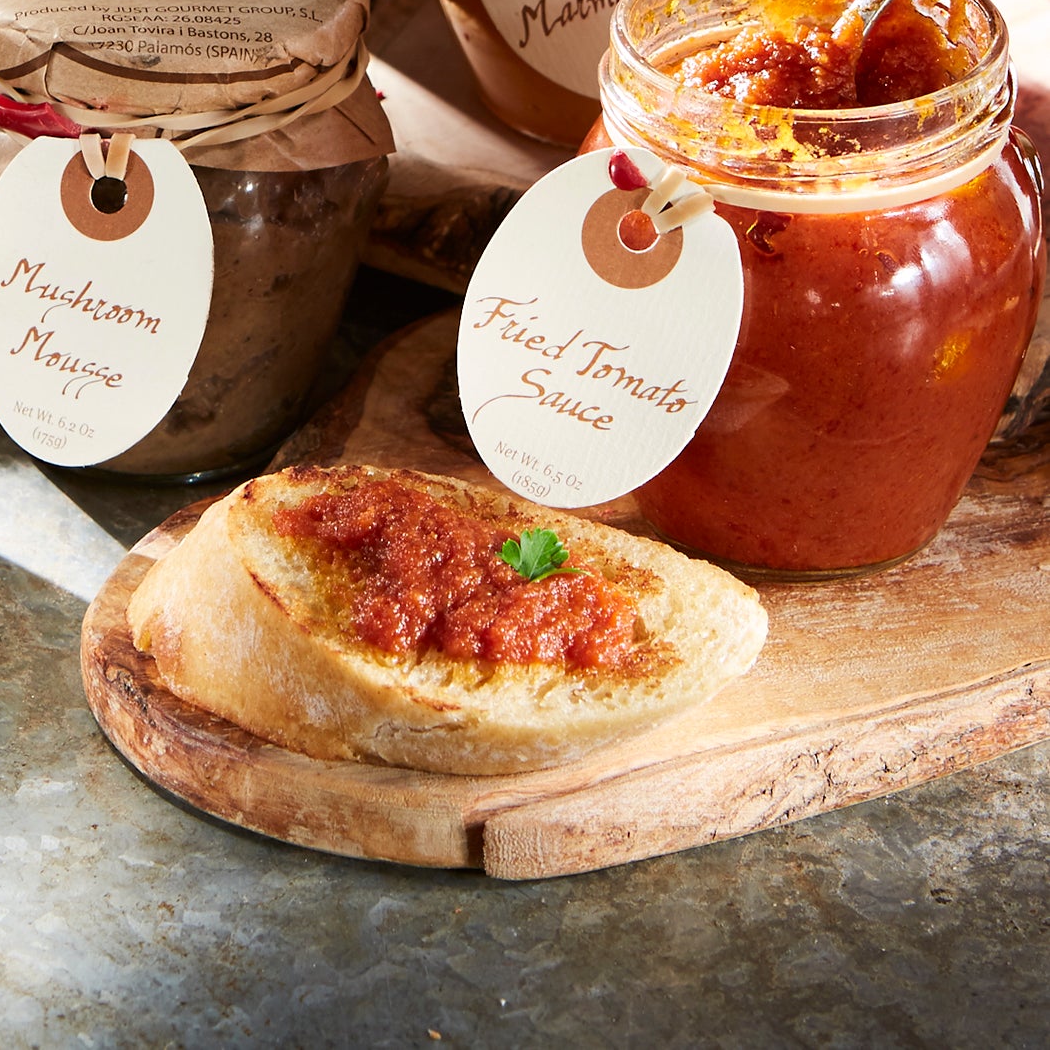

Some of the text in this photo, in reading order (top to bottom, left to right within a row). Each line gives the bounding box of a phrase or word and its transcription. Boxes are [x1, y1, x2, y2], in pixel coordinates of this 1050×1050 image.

[13, 3, 325, 24] Produced by JUST GOURMET GROUP, S.L.
[101, 13, 242, 26] RGSEAA: 26.08425
[72, 24, 127, 37] C/Joan
[131, 25, 176, 36] Tovira
[186, 26, 251, 43] Bastons,
[254, 30, 274, 43] 28
[137, 39, 202, 56] Palamós
[0, 257, 163, 335] Mushroom
[9, 324, 125, 400] Mousse
[471, 296, 699, 415] Fried Tomato
[471, 367, 617, 432] Sauce
[12, 399, 96, 440] Net Wt. 6.2 Oz
[31, 425, 69, 451] (175g)
[494, 439, 584, 493] Net Wt. 6.5 Oz
[510, 469, 552, 499] (185g)
